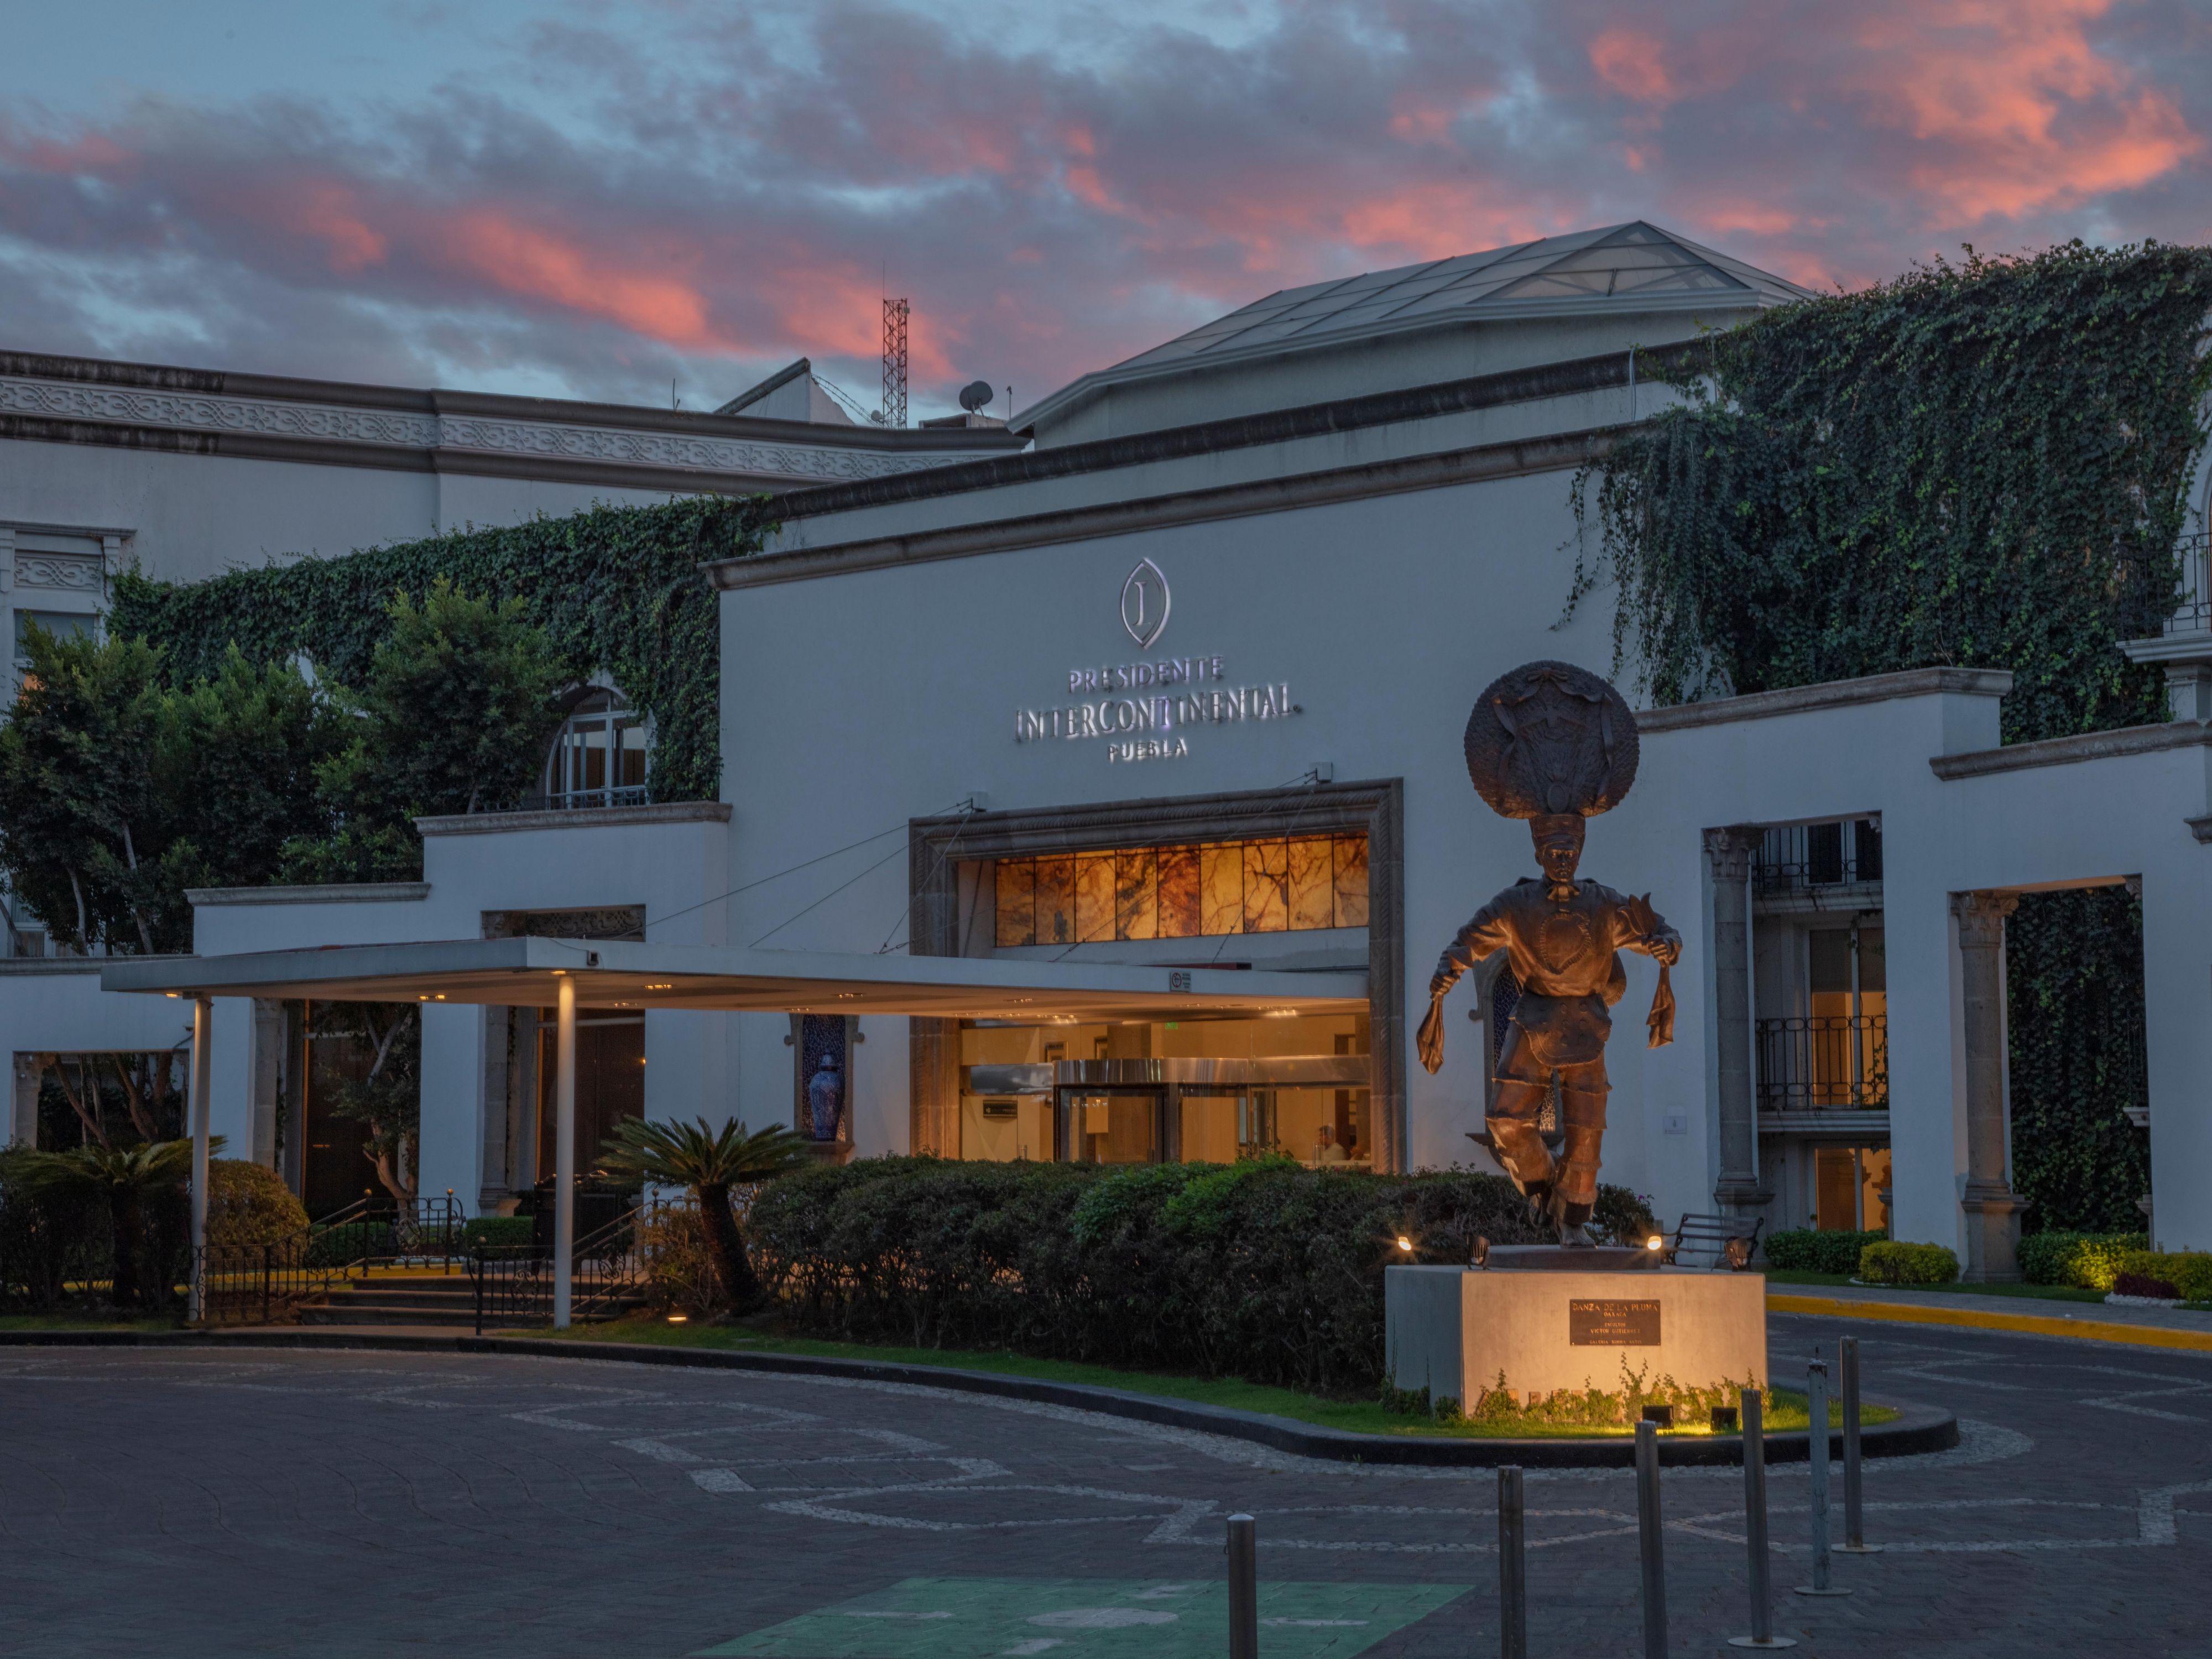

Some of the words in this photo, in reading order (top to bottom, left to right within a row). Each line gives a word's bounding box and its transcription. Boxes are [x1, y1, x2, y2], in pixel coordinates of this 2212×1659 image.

[1068, 656, 1224, 693] PRESIDENTE
[1013, 684, 1292, 742] INTERCONTINENTAL
[1108, 738, 1187, 762] PUEBLA
[1573, 1303, 1600, 1311] DANZA
